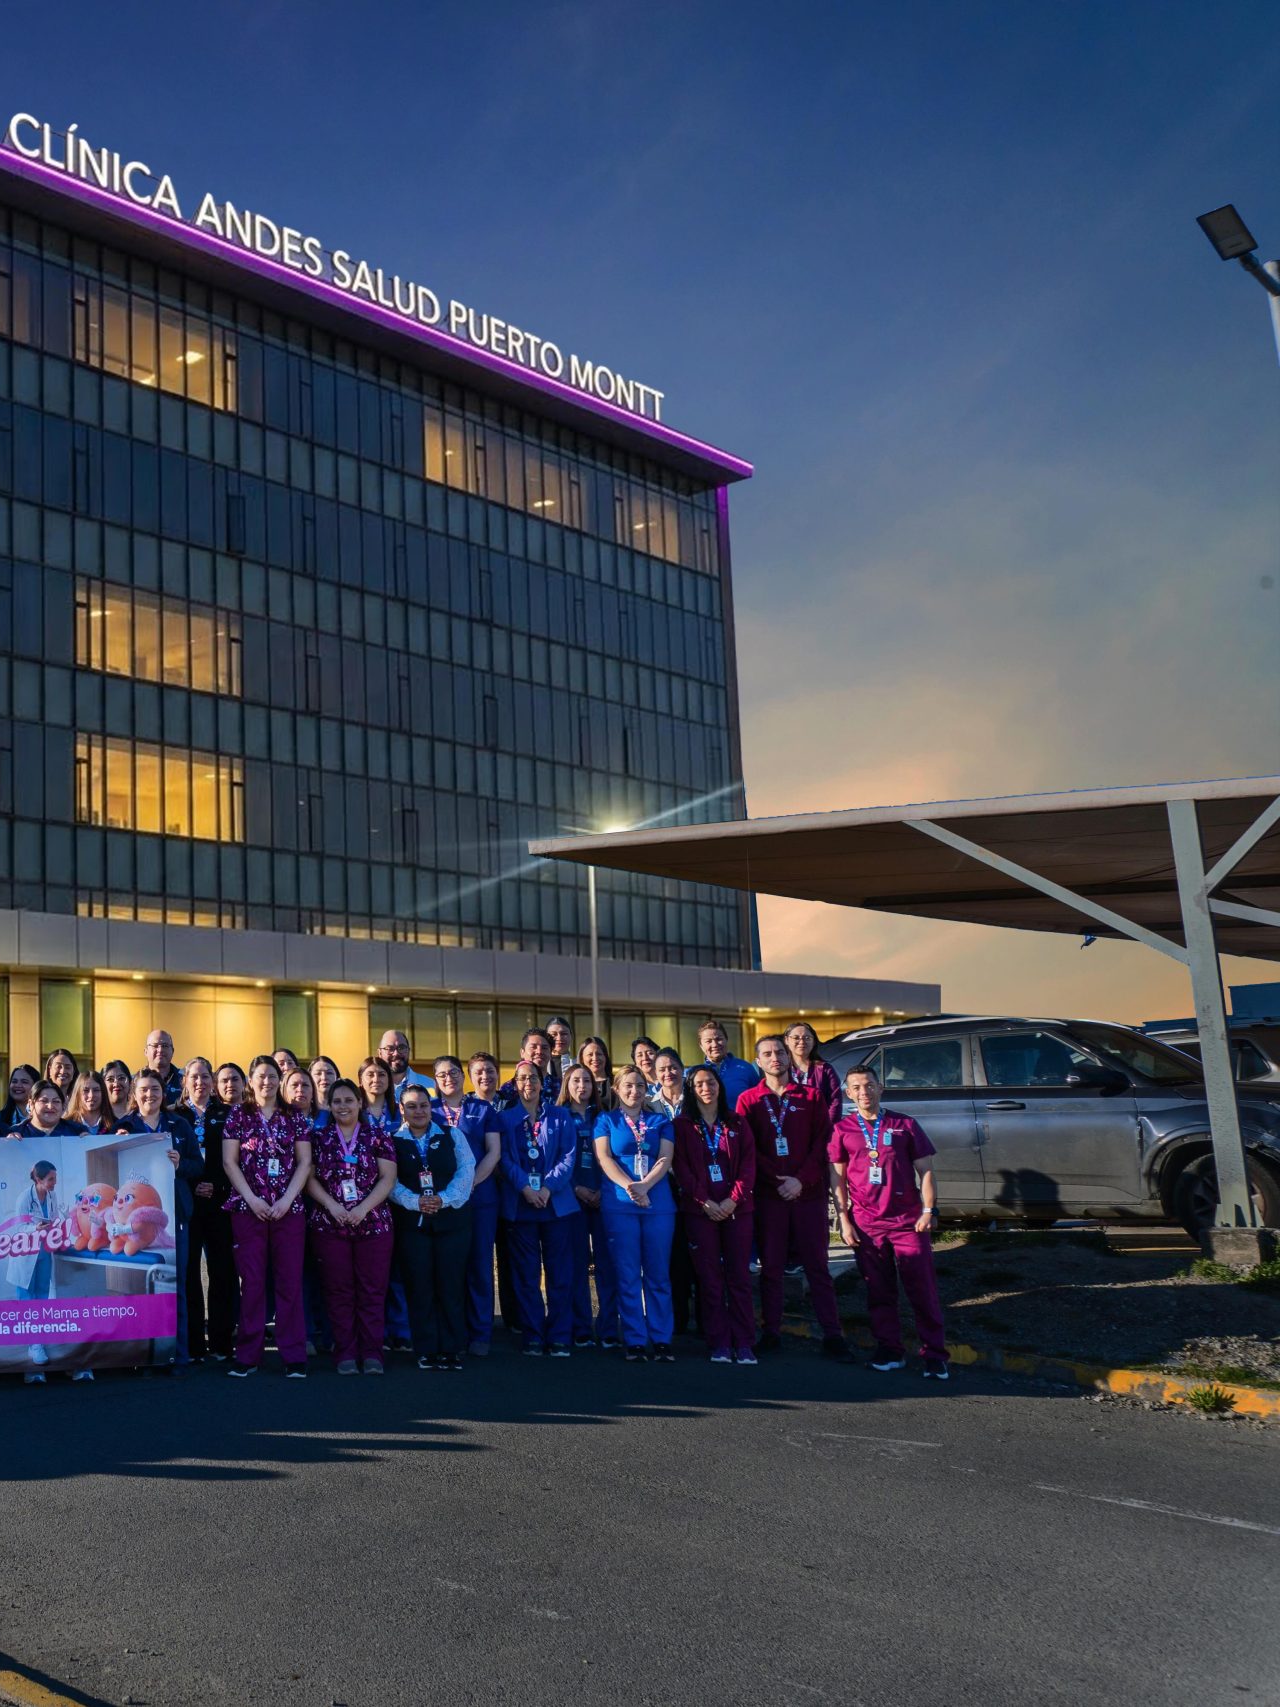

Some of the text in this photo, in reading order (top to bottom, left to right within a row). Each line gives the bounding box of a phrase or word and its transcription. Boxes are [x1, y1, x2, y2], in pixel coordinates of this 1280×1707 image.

[8, 112, 664, 422] CLÍNICA ANDES SALUD PUERTO MONTT
[23, 1308, 39, 1320] de
[42, 1307, 80, 1320] Mama
[82, 1308, 90, 1318] a
[92, 1304, 138, 1319] tiempo,
[13, 1319, 81, 1335] diferencia.
